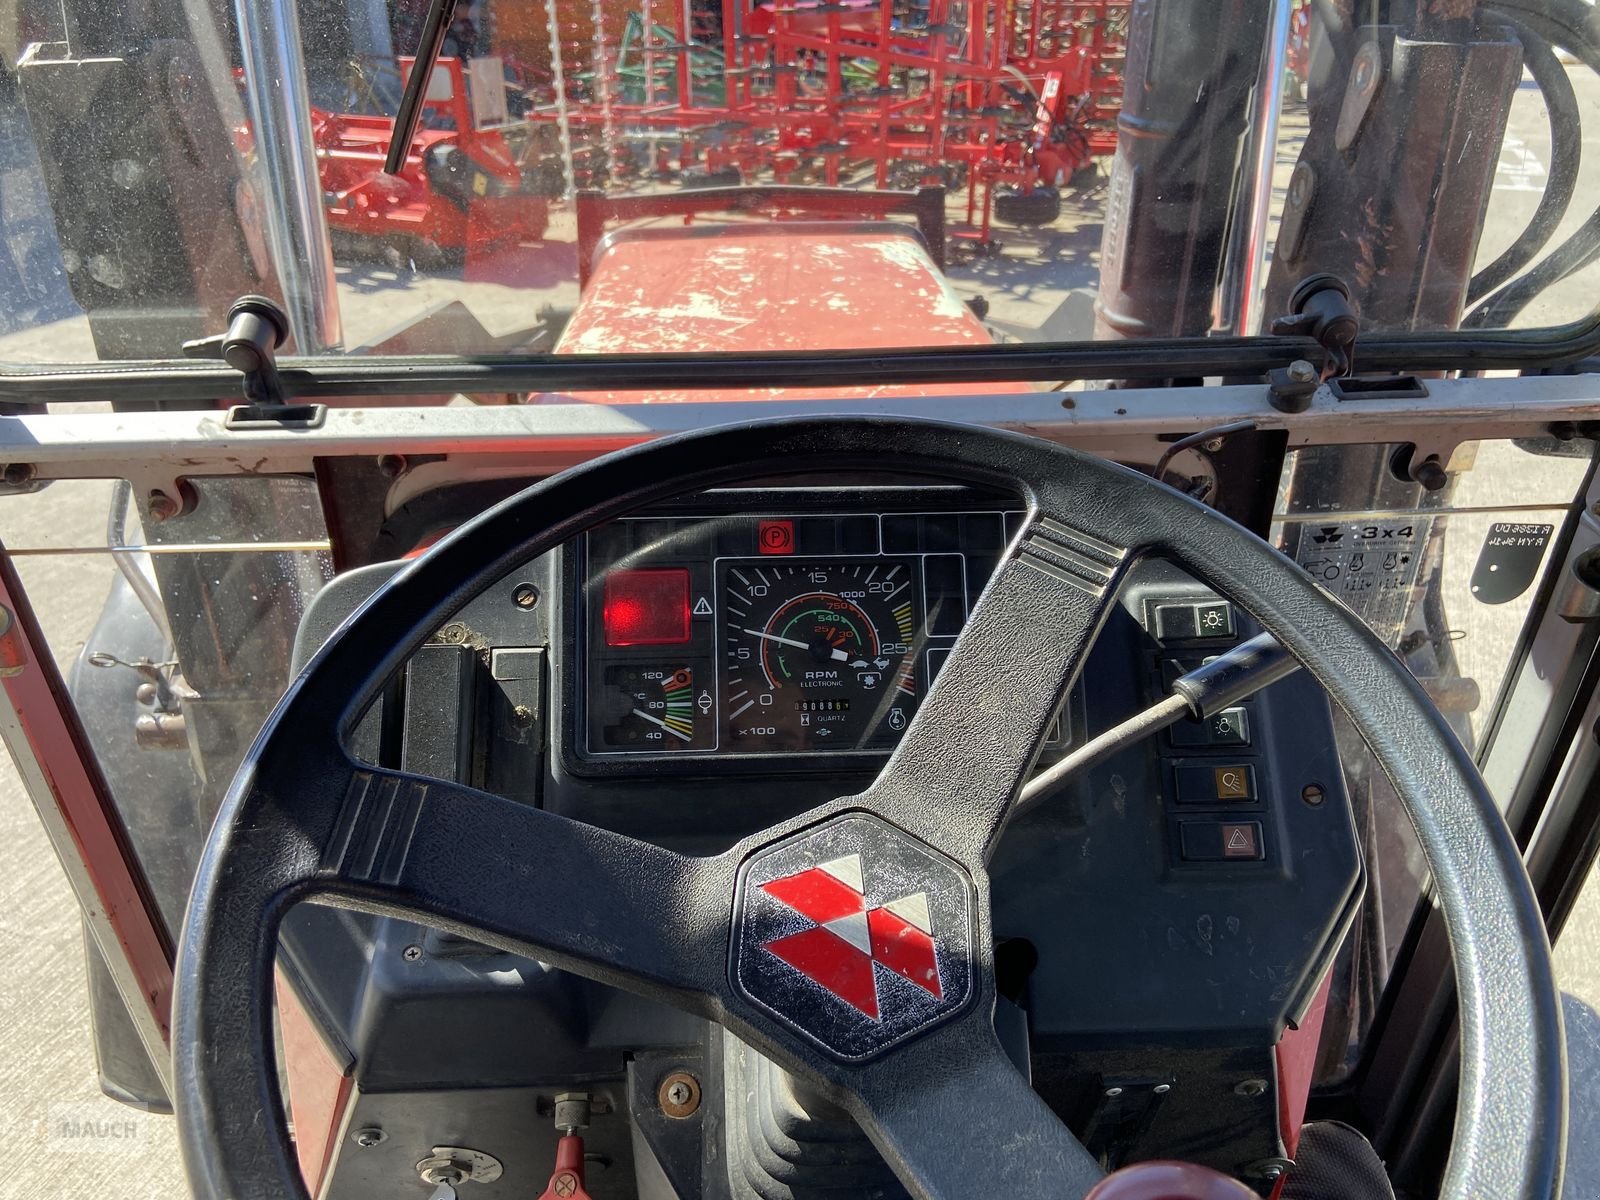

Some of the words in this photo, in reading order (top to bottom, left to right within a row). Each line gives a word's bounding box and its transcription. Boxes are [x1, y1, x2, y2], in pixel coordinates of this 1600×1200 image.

[808, 571, 828, 583] 15
[747, 585, 767, 597] 10
[868, 581, 895, 593] 20
[839, 591, 866, 599] 1000
[826, 602, 848, 610] 750
[817, 614, 840, 622] 540
[814, 625, 829, 633] 25
[881, 642, 908, 655] 25
[737, 647, 750, 660] 5
[641, 671, 664, 680] 120
[805, 671, 838, 679] RPM
[800, 680, 844, 688] ELECTRONIC
[633, 692, 647, 700] °C
[760, 694, 773, 706] 0
[648, 701, 665, 709] 80
[645, 732, 663, 740] 40
